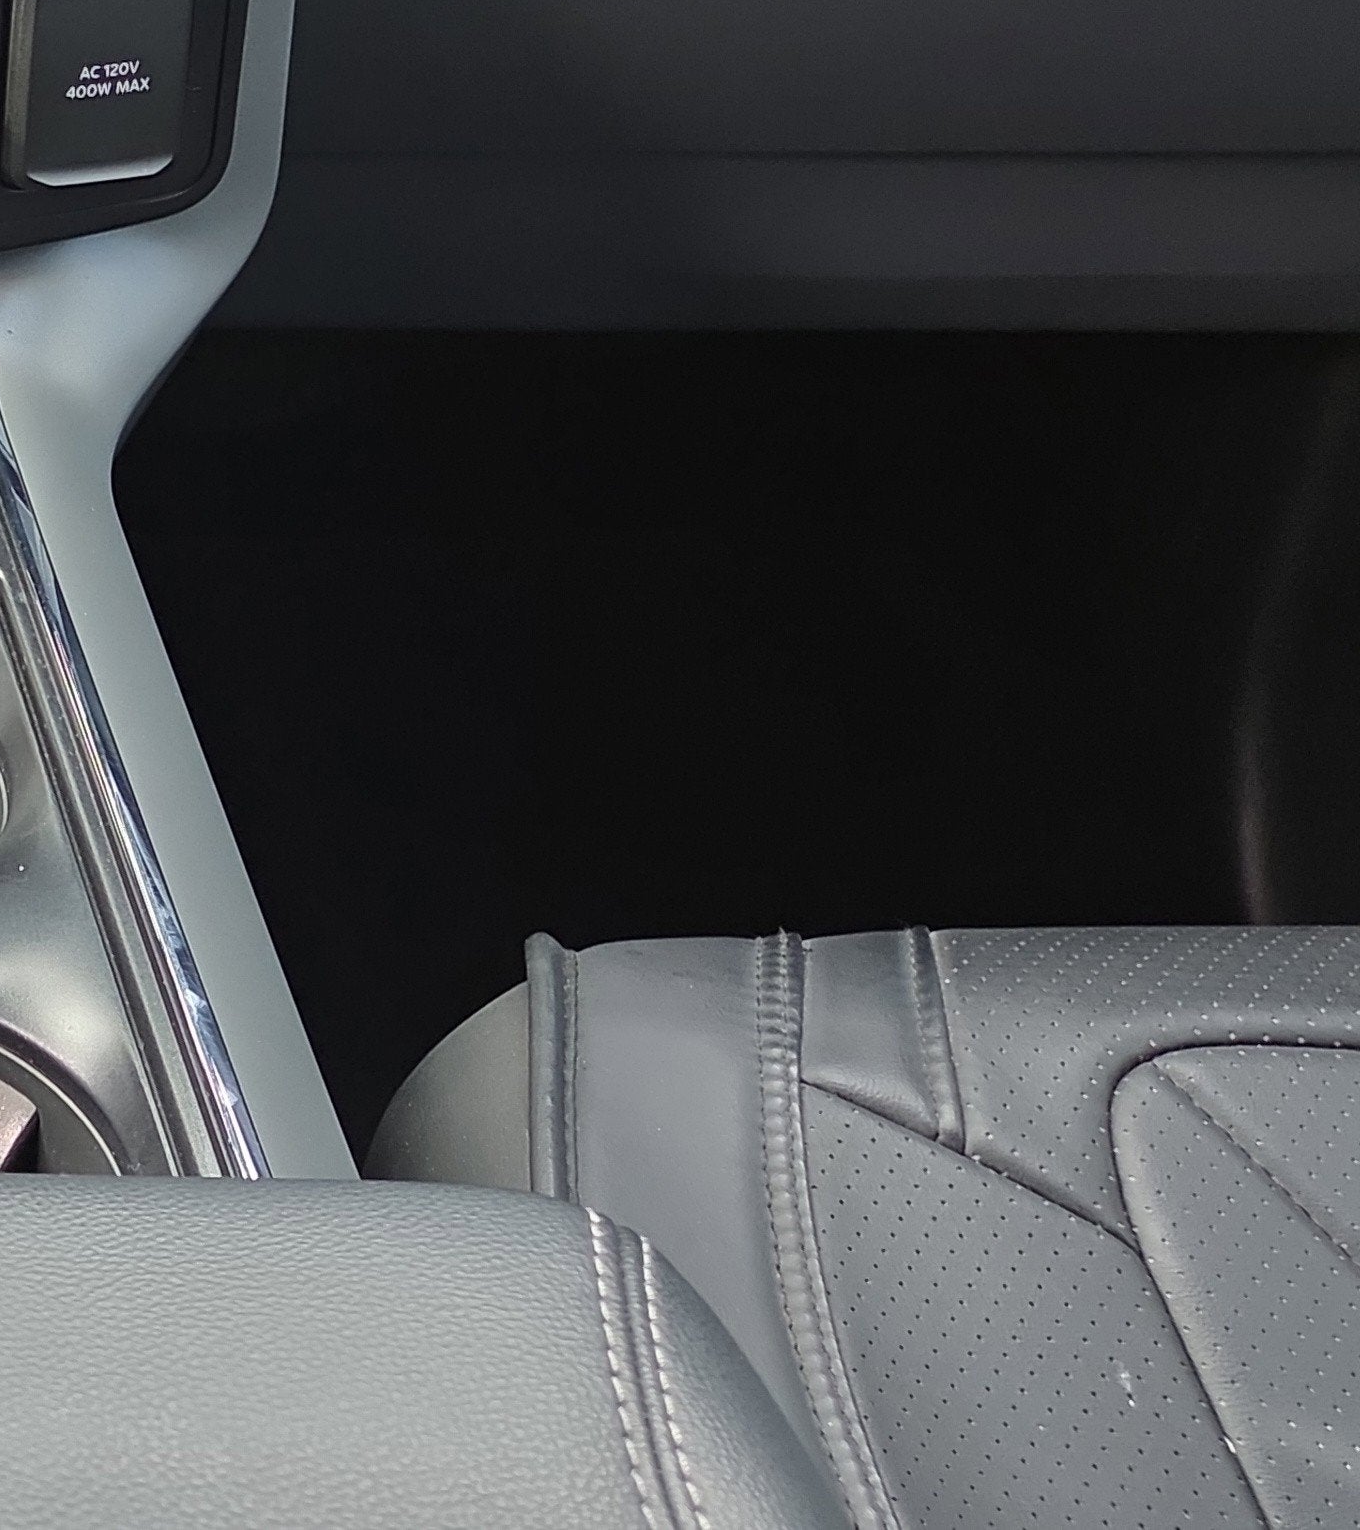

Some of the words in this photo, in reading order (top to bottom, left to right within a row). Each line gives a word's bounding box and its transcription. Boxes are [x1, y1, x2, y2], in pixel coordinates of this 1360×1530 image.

[79, 65, 102, 81] AC
[103, 60, 140, 78] 120V
[65, 81, 114, 101] 400W
[115, 76, 151, 96] MAX
